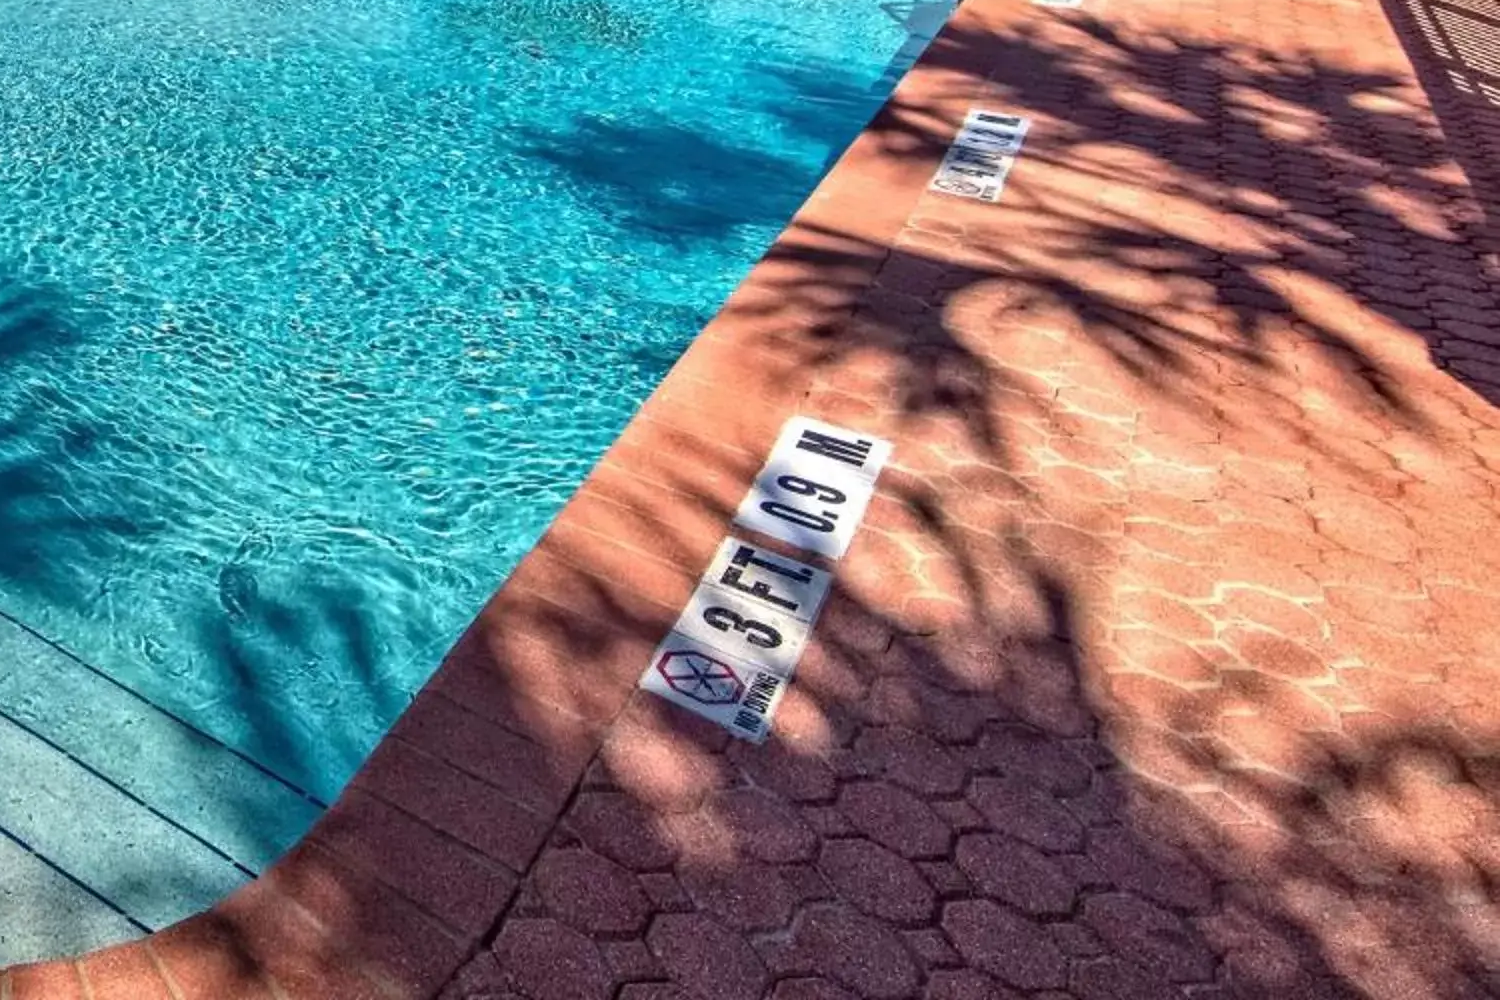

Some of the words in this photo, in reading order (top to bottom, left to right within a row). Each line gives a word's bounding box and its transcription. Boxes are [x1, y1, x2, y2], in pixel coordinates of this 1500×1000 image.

[759, 474, 847, 533] 0.9
[719, 545, 814, 612] FT.
[702, 606, 783, 649] 3
[742, 671, 781, 715] DIVING
[732, 708, 763, 734] NO
